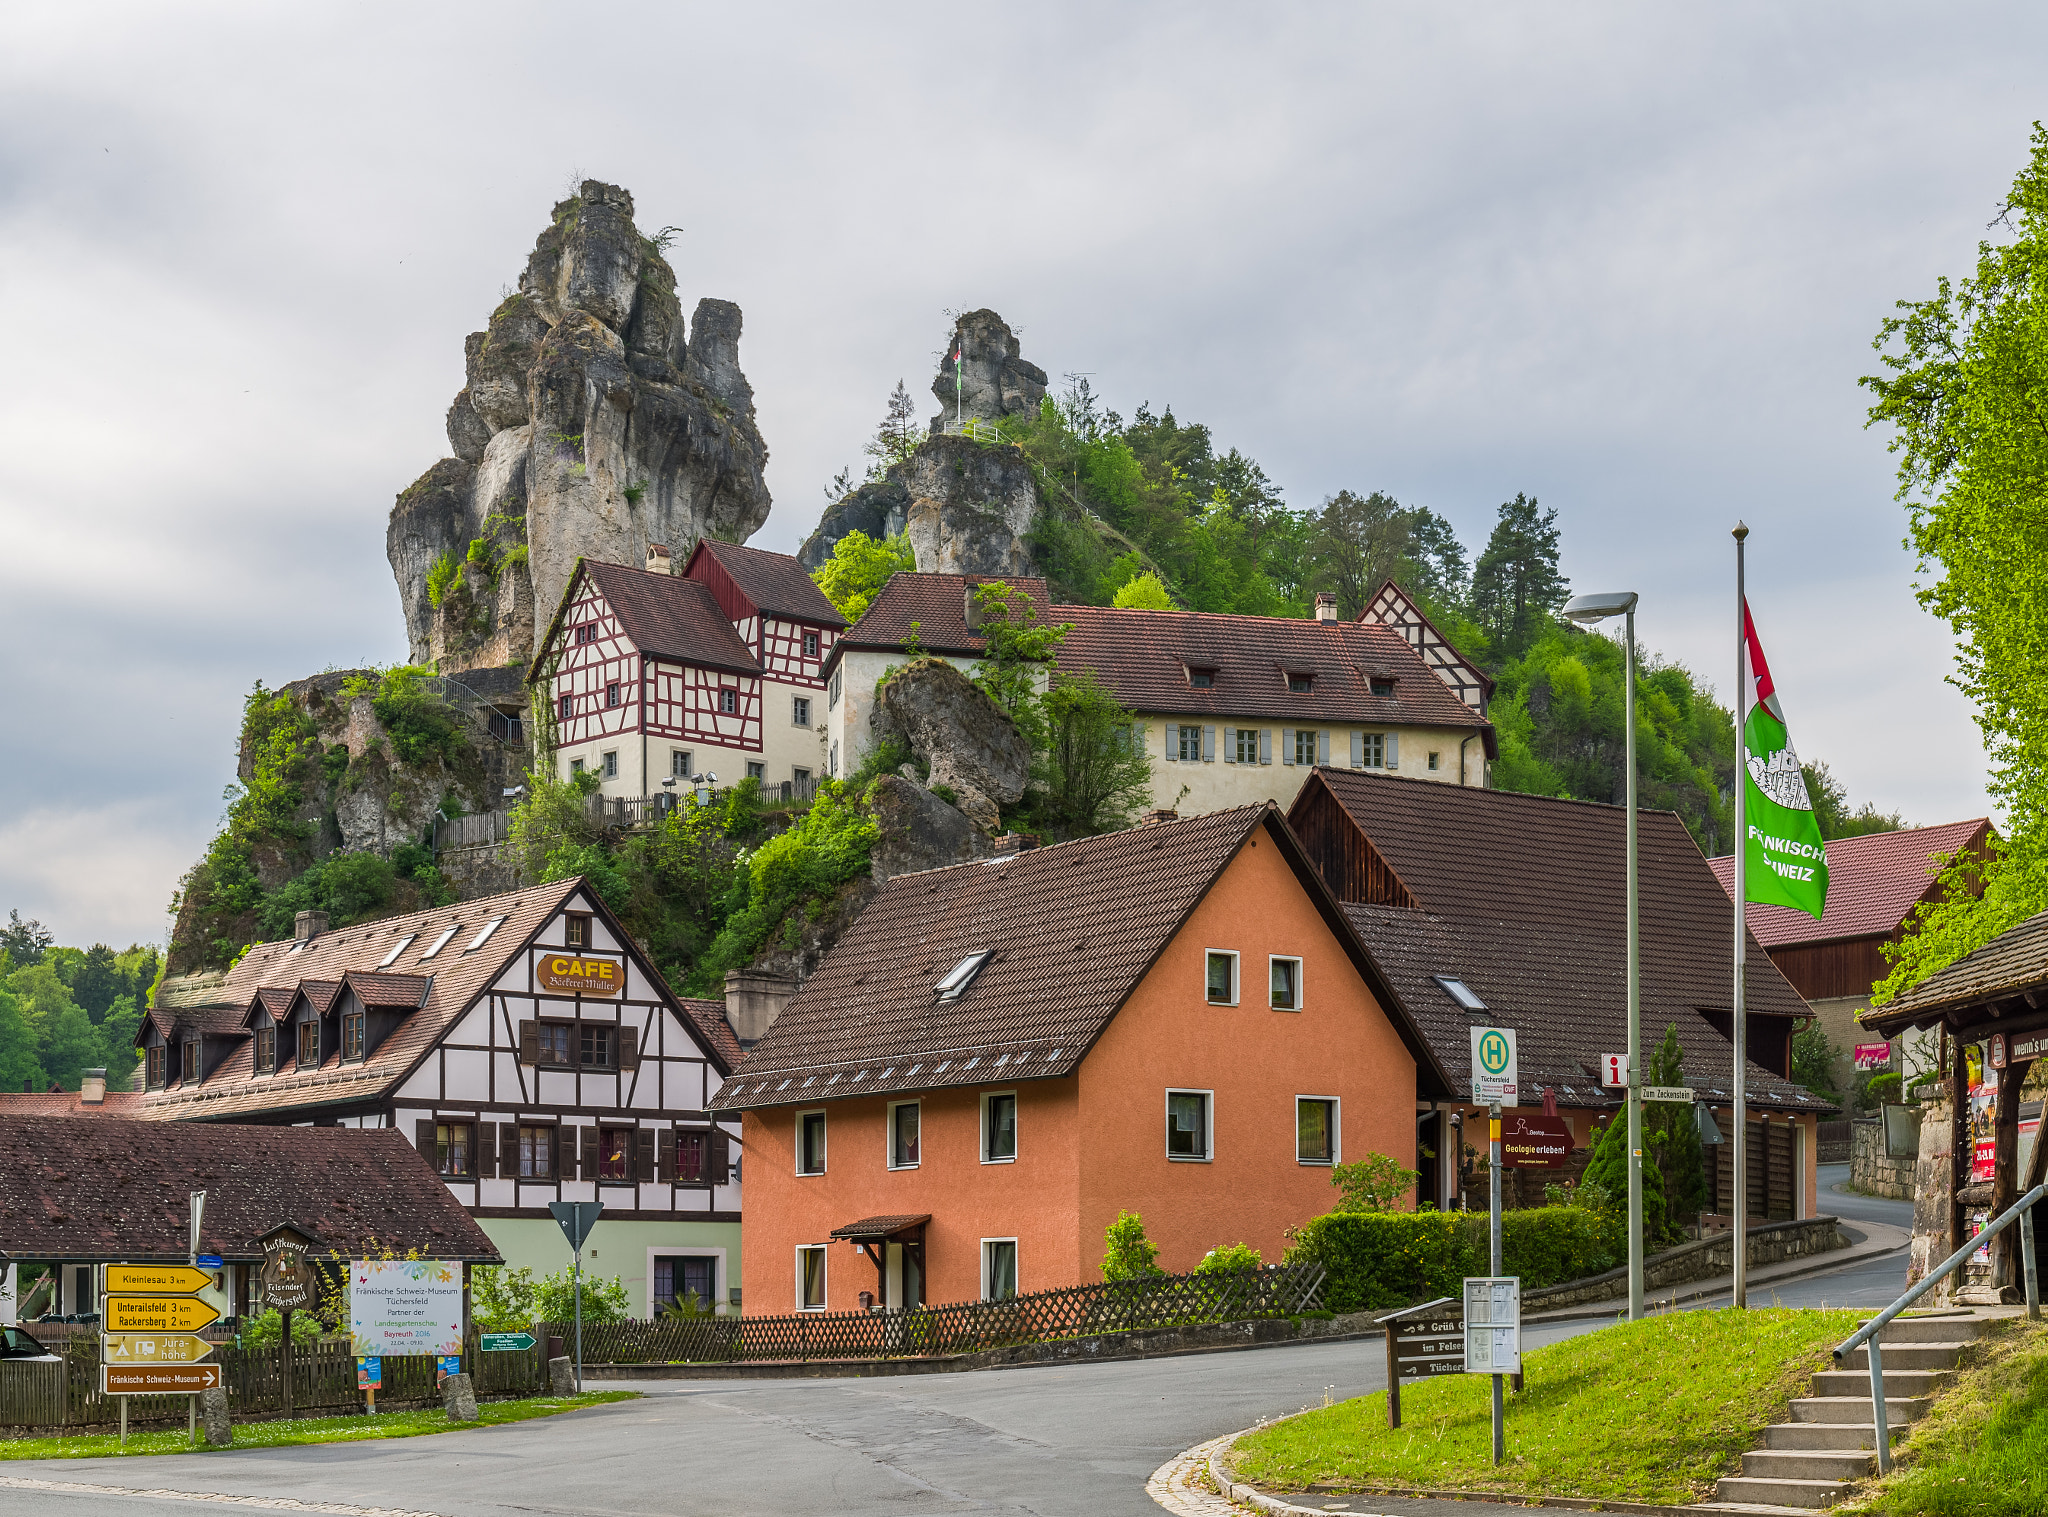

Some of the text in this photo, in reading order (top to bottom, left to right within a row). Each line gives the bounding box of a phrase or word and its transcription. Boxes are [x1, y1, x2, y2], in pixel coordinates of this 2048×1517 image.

[551, 958, 613, 979] CAFE
[549, 976, 615, 991] Bäckerei Müller
[2014, 1038, 2040, 1056] wenn's
[1487, 1040, 1502, 1065] H
[1481, 1075, 1510, 1084] Tüchersfeld
[1643, 1088, 1690, 1100] Zum Zeckenstein
[1505, 1144, 1565, 1155] Geologie erleben!
[263, 1238, 309, 1254] Luftkurort
[122, 1275, 167, 1284] Kleinlesau
[169, 1276, 175, 1284] 3
[268, 1283, 304, 1292] Felsendorf
[356, 1287, 458, 1295] Fränkische Schweiz-Museum
[266, 1291, 308, 1308] Tüchersfeld
[386, 1297, 429, 1305] Tüchersfeld
[117, 1302, 191, 1312] Unterailsfeld 3 km
[119, 1316, 191, 1328] Rackersberg 2 km
[374, 1319, 438, 1328] Landesgartenschau
[1431, 1321, 1455, 1332] Grüß
[384, 1330, 413, 1338] Bayreuth
[162, 1338, 190, 1348] Jura-
[1422, 1343, 1435, 1352] im
[161, 1351, 186, 1360] höhe
[110, 1374, 200, 1384] Fränkische Schweiz-Museum
